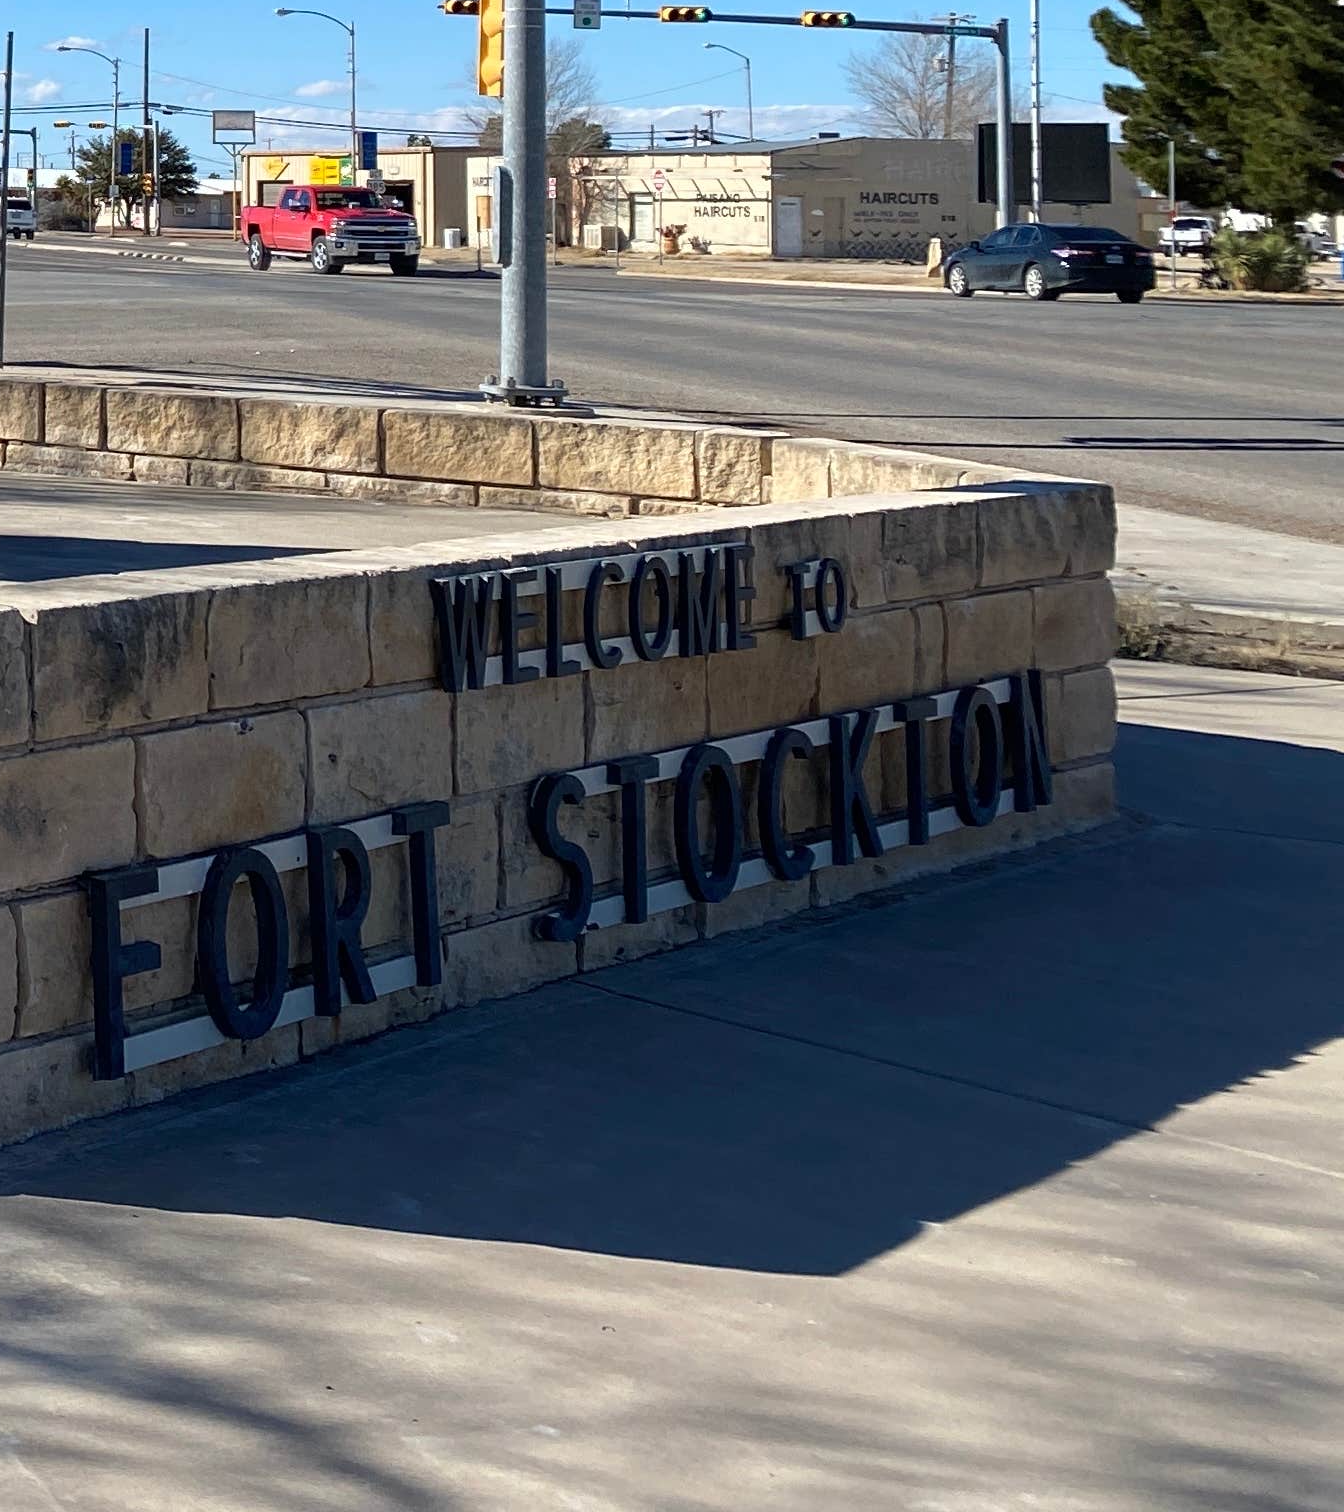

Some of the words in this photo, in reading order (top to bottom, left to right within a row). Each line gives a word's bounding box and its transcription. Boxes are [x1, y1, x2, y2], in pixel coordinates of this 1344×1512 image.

[694, 206, 751, 218] HAIRCUTS
[859, 191, 939, 205] HAIRCUTS
[429, 544, 757, 694] WELCOME
[787, 556, 848, 641] TO
[86, 800, 451, 1081] FORT
[526, 669, 1054, 942] STOCKTON
